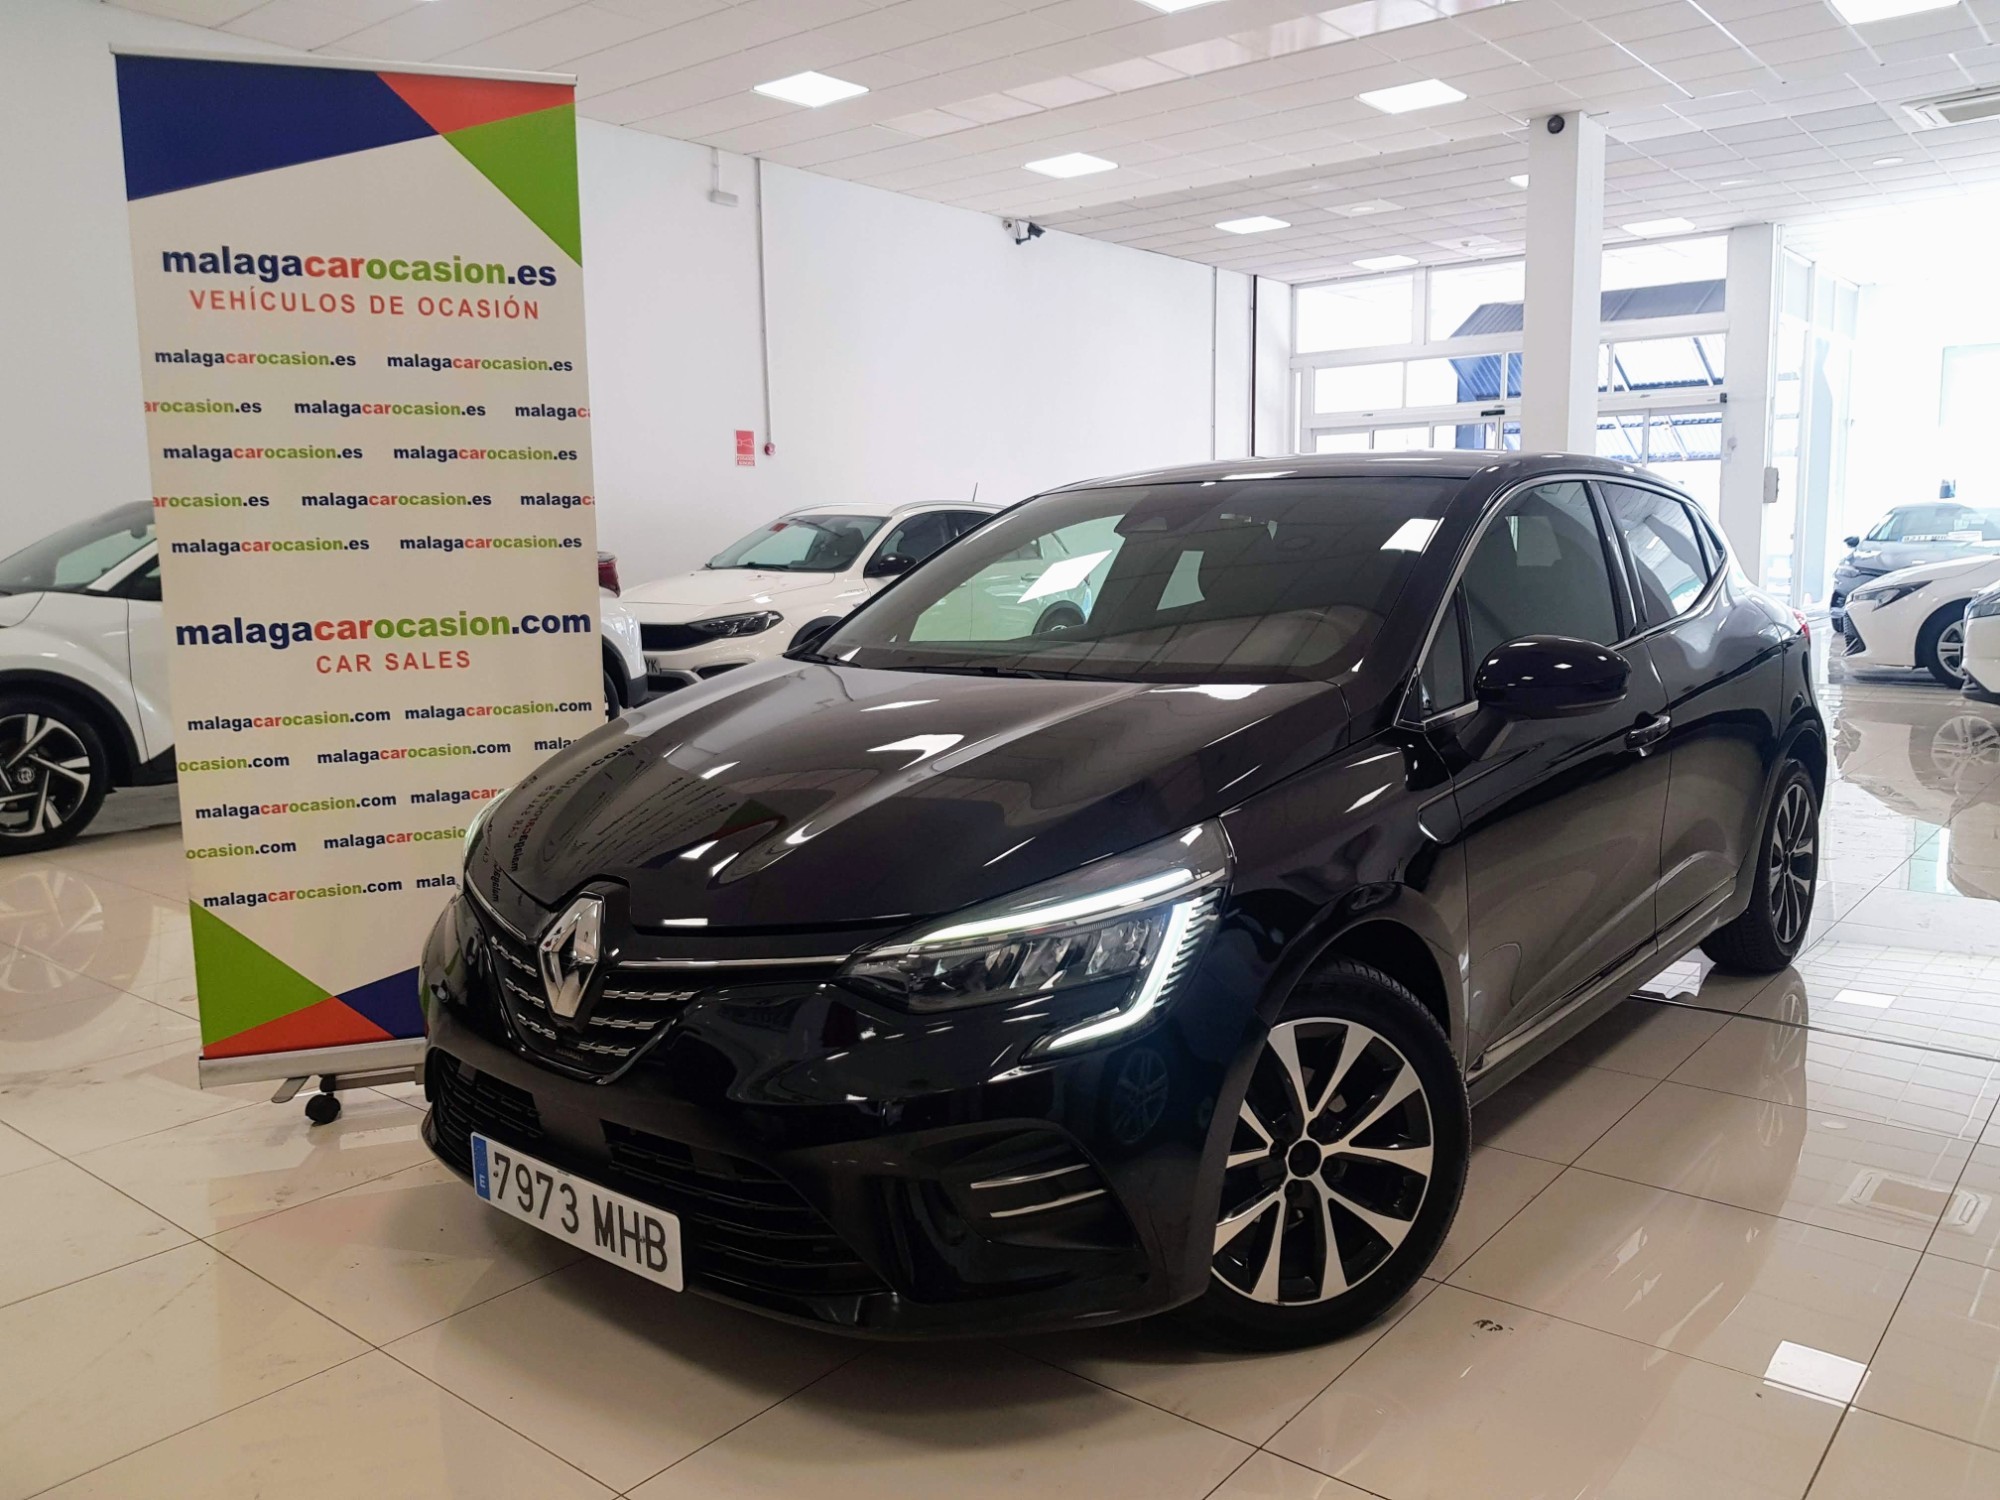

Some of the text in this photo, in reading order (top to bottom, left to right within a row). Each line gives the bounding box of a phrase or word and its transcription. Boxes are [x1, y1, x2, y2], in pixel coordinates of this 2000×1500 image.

[162, 245, 558, 286] malagacarocasion.es
[189, 286, 538, 319] VEHÍCULOS DE OCASIÓN
[155, 349, 356, 367] malagacarocasion.es
[387, 353, 573, 371] malagacarocasion.es
[294, 400, 486, 418] malagacarocasion.es
[163, 444, 363, 463] malagacarocasion.es
[394, 445, 578, 463] malagacarocasion.es
[301, 492, 492, 509] malagacarocasion.es
[171, 537, 369, 554] malagacarocasion.es
[400, 535, 582, 552] malagacarocasion.es
[176, 611, 591, 649] malagacarocasion.com
[316, 650, 470, 674] CAR SALES
[405, 701, 592, 721] malagacarocasion.com
[187, 711, 391, 732] malagacarocasion.com
[317, 743, 511, 764] malagacarocasion.com
[195, 795, 396, 819] malagacarocasion.com
[203, 882, 403, 907] malagacarocasion.com
[479, 1174, 486, 1188] E
[494, 1151, 668, 1273] 7973 MHB
